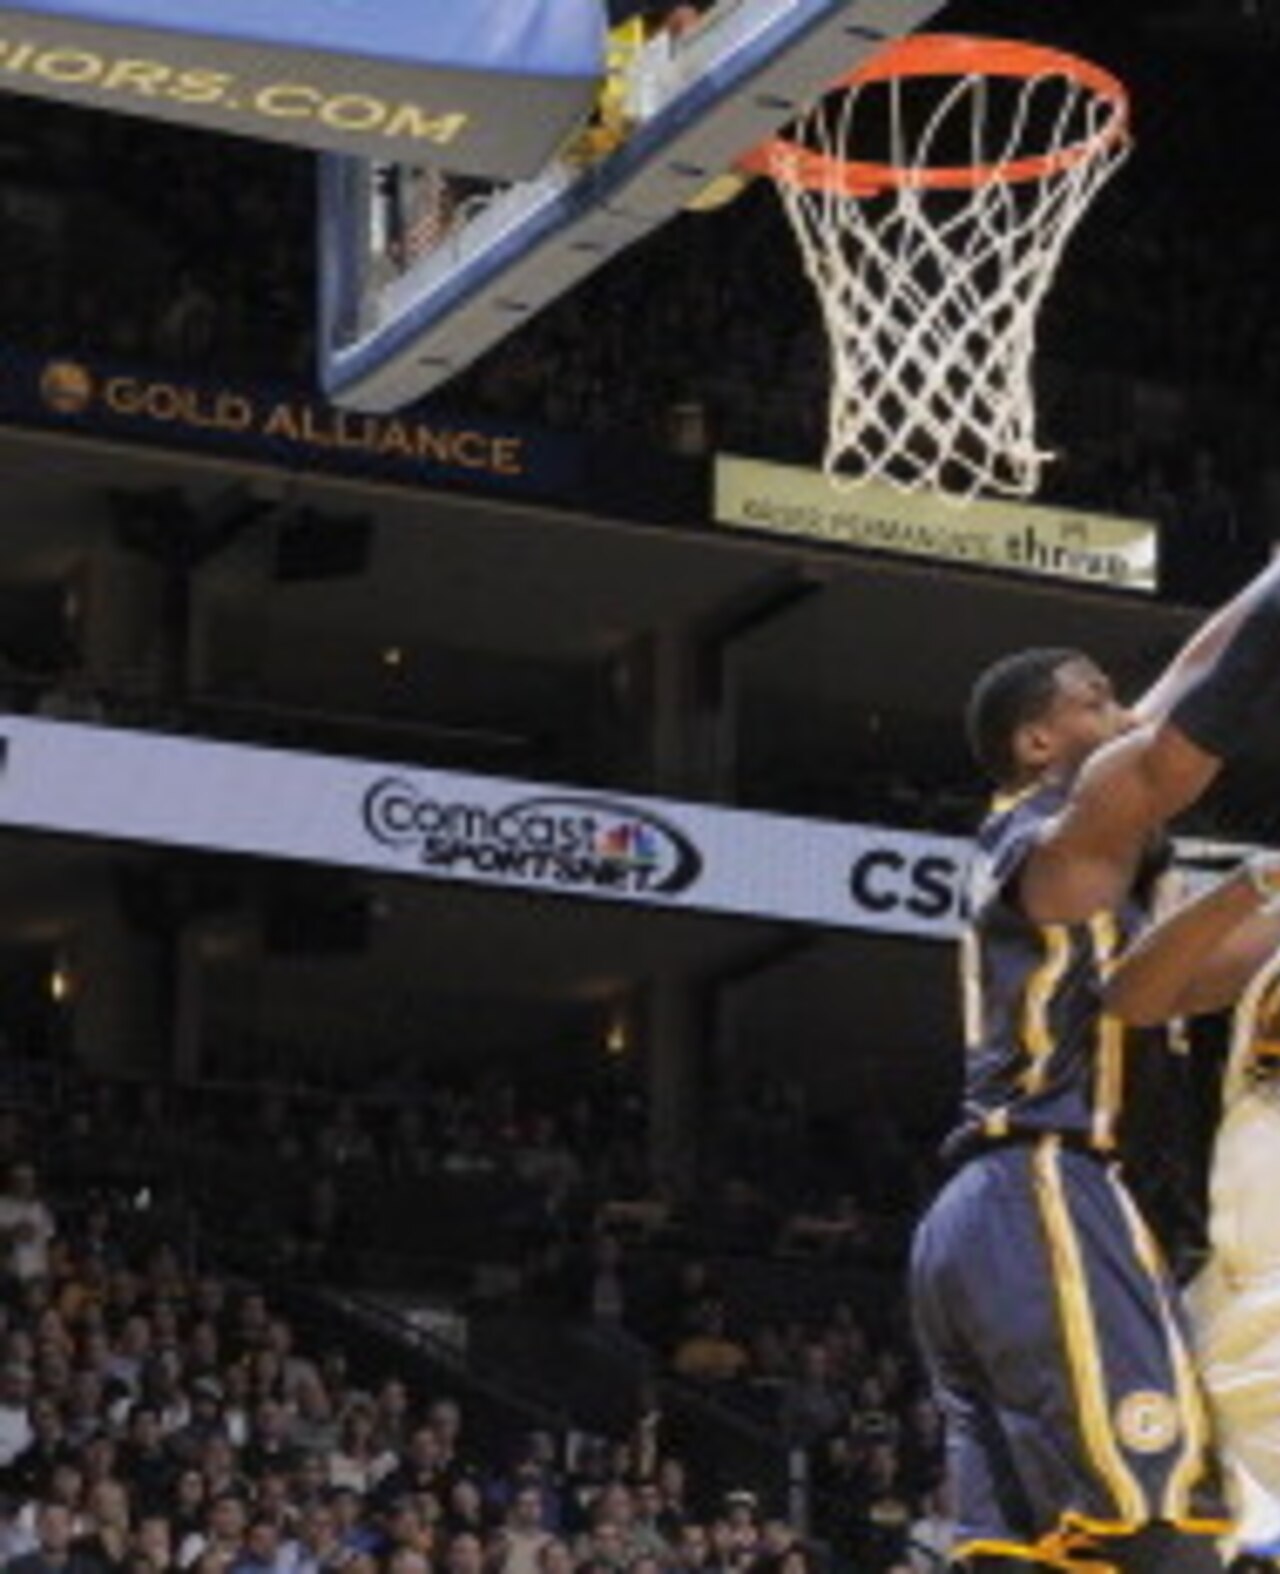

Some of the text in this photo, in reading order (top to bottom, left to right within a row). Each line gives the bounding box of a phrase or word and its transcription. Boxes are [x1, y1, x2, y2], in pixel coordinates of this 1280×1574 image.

[0, 40, 467, 144] IORS.COM
[105, 376, 523, 475] GOLD ALLIANCE
[421, 834, 657, 892] SPORTSNET
